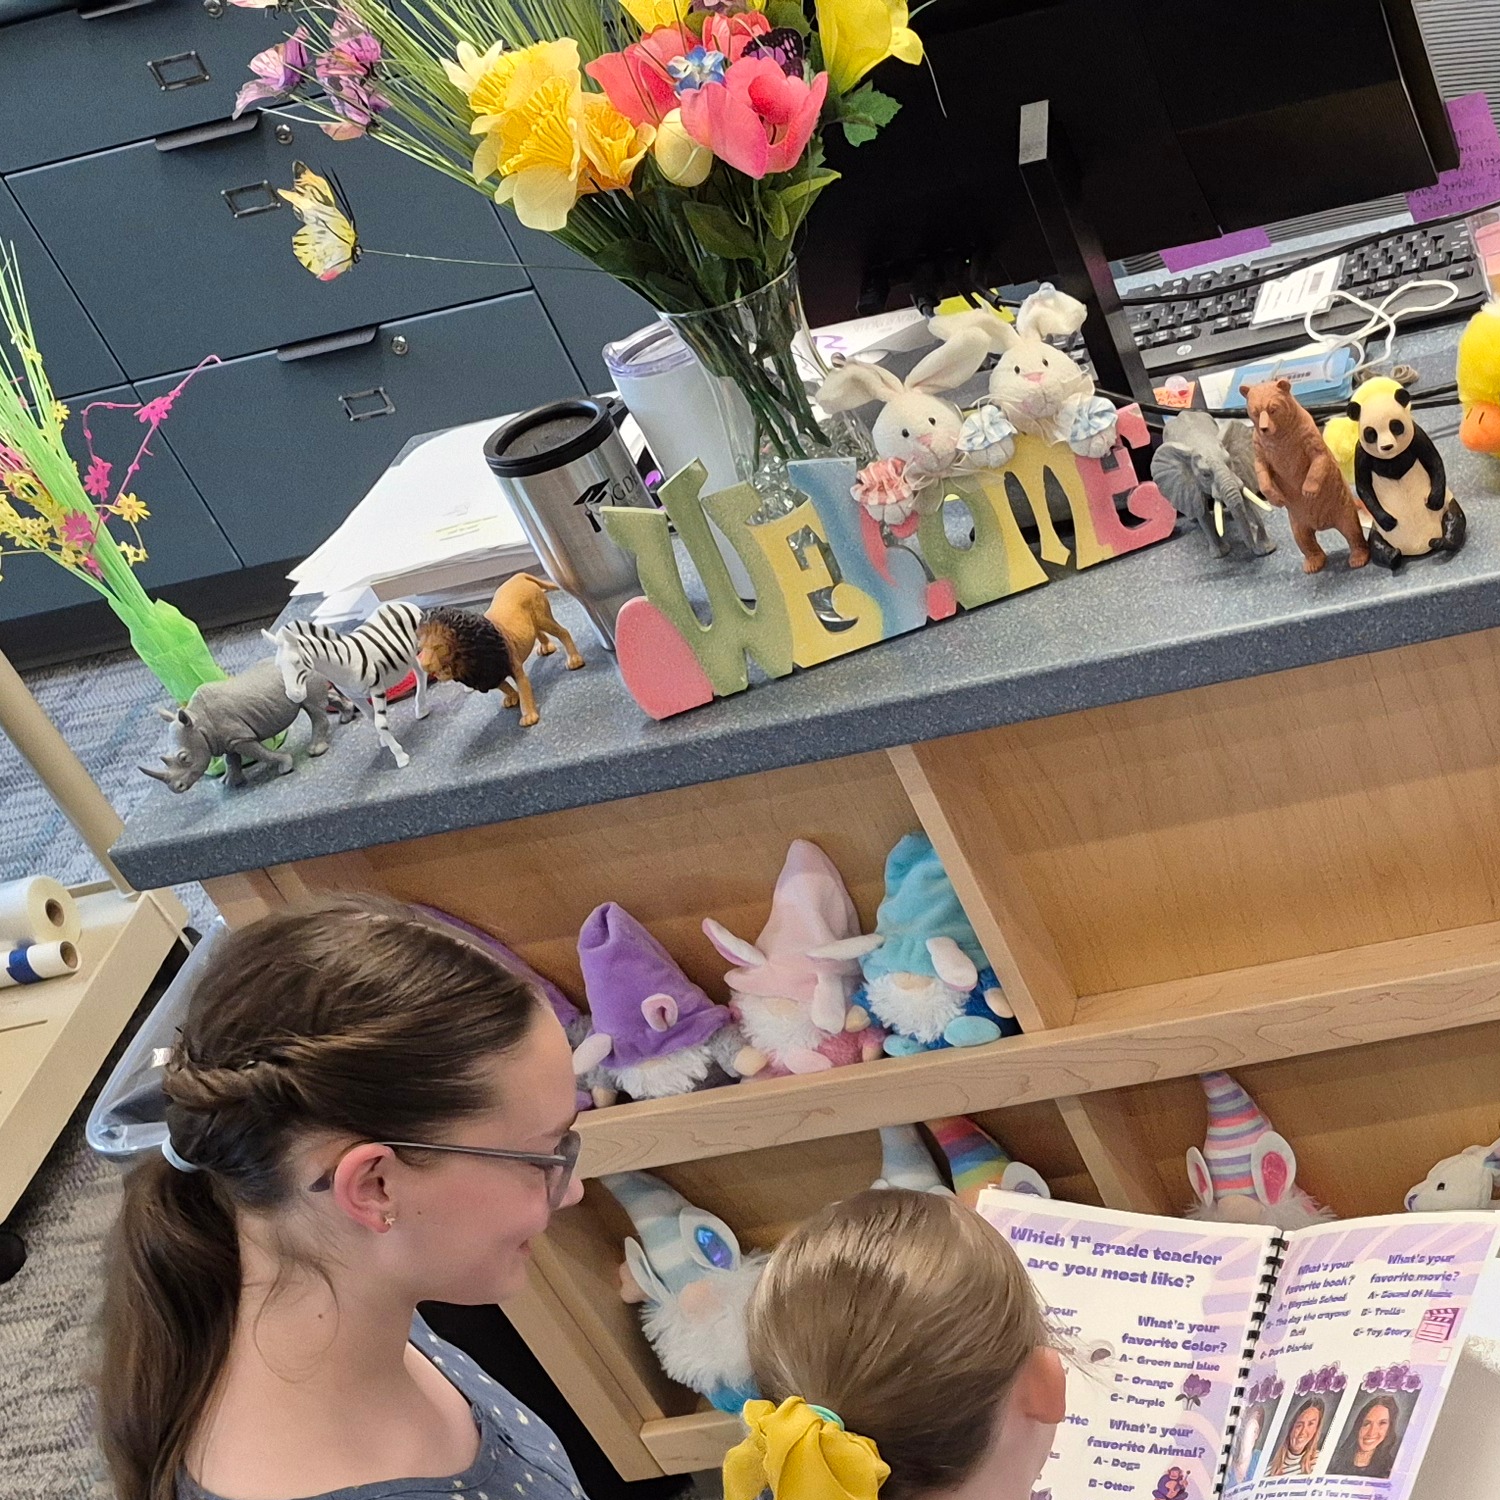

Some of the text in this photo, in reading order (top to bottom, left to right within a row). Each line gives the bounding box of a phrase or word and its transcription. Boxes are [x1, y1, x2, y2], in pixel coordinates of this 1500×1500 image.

[600, 402, 1177, 697] WELCOME
[1010, 1226, 1223, 1266] Which 1st grade teacher
[1387, 1253, 1456, 1266] What's your
[1027, 1257, 1195, 1288] are you most like?
[1298, 1261, 1354, 1275] What's your
[1370, 1270, 1461, 1284] favorite movie?
[1285, 1274, 1356, 1295] favorite book?
[1319, 1292, 1348, 1304] School
[1380, 1290, 1410, 1299] Sound
[1044, 1304, 1078, 1317] your
[1288, 1315, 1302, 1325] day
[1303, 1312, 1316, 1321] the
[1317, 1309, 1351, 1321] crayons
[1137, 1315, 1221, 1334] What's your
[1366, 1327, 1384, 1338] Toy
[1384, 1327, 1412, 1338] Story
[1121, 1332, 1228, 1353] favorite Color?
[1286, 1342, 1314, 1354] Diaries
[1136, 1355, 1171, 1368] Green
[1173, 1360, 1195, 1370] and
[1196, 1362, 1221, 1372] blue
[1131, 1376, 1175, 1390] Orange
[1126, 1394, 1166, 1408] Purple
[1109, 1418, 1194, 1438] What's your
[1087, 1435, 1206, 1459] favorite Animal?
[1111, 1458, 1141, 1471] Dogs
